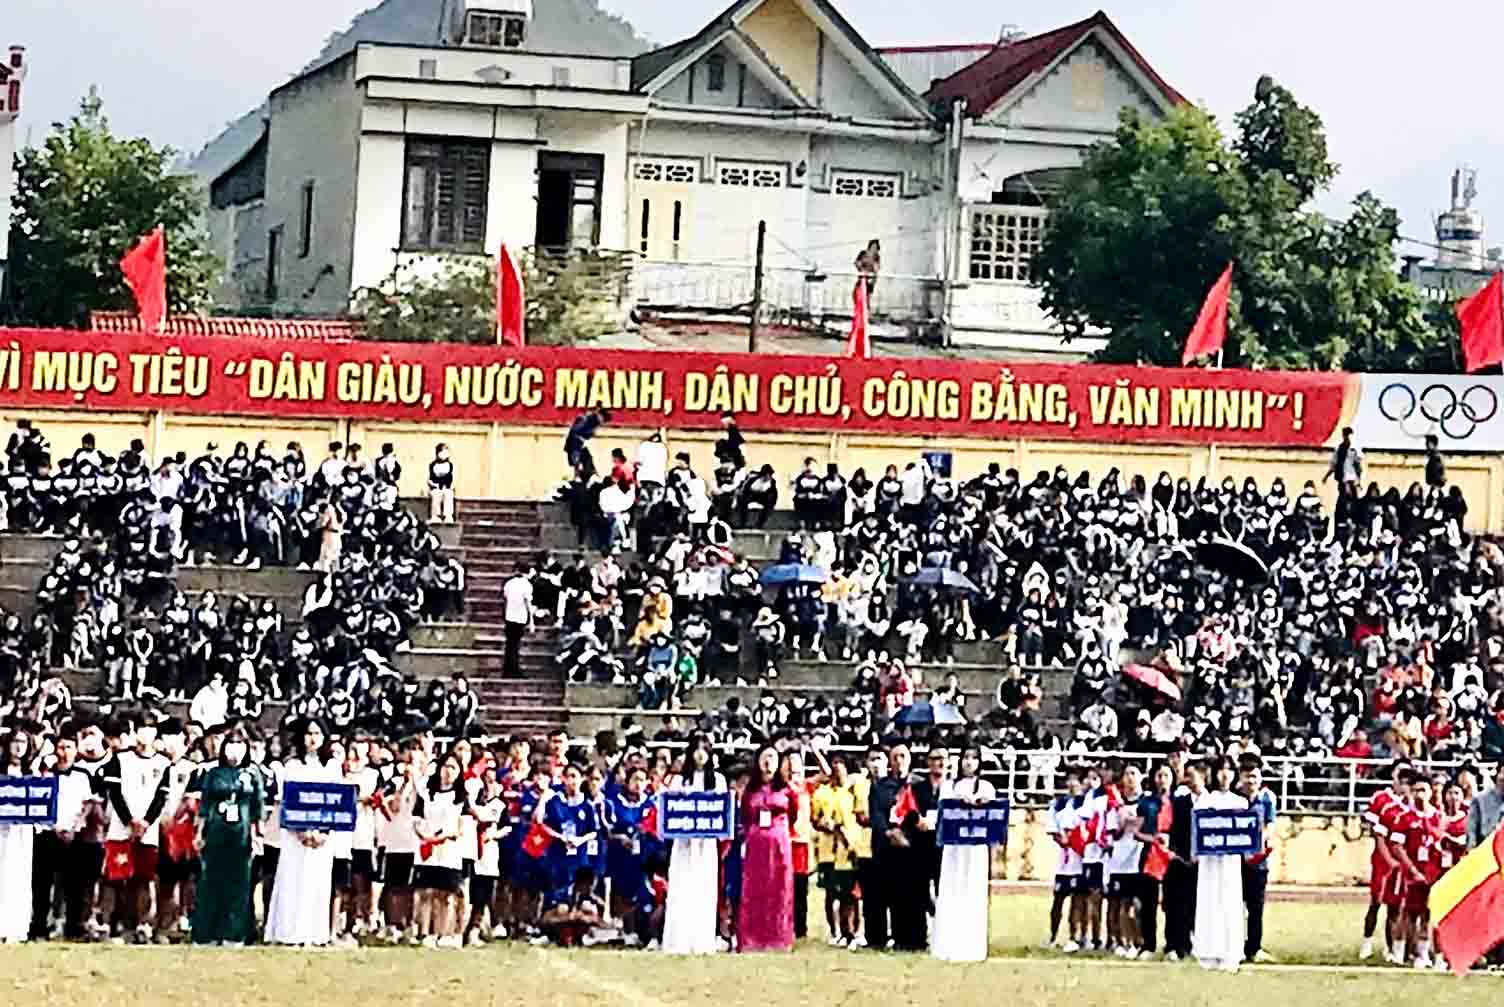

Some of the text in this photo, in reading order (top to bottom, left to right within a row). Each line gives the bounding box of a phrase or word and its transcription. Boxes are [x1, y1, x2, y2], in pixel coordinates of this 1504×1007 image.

[32, 350, 118, 401] MỤC
[129, 346, 209, 397] TIÊU
[336, 354, 433, 409] GIÀU,
[443, 358, 544, 408] NƯỚC
[684, 364, 759, 413] DÂN
[769, 363, 852, 422] CHỦ,
[862, 370, 960, 419] CÔNG
[1088, 379, 1160, 427] VĂN
